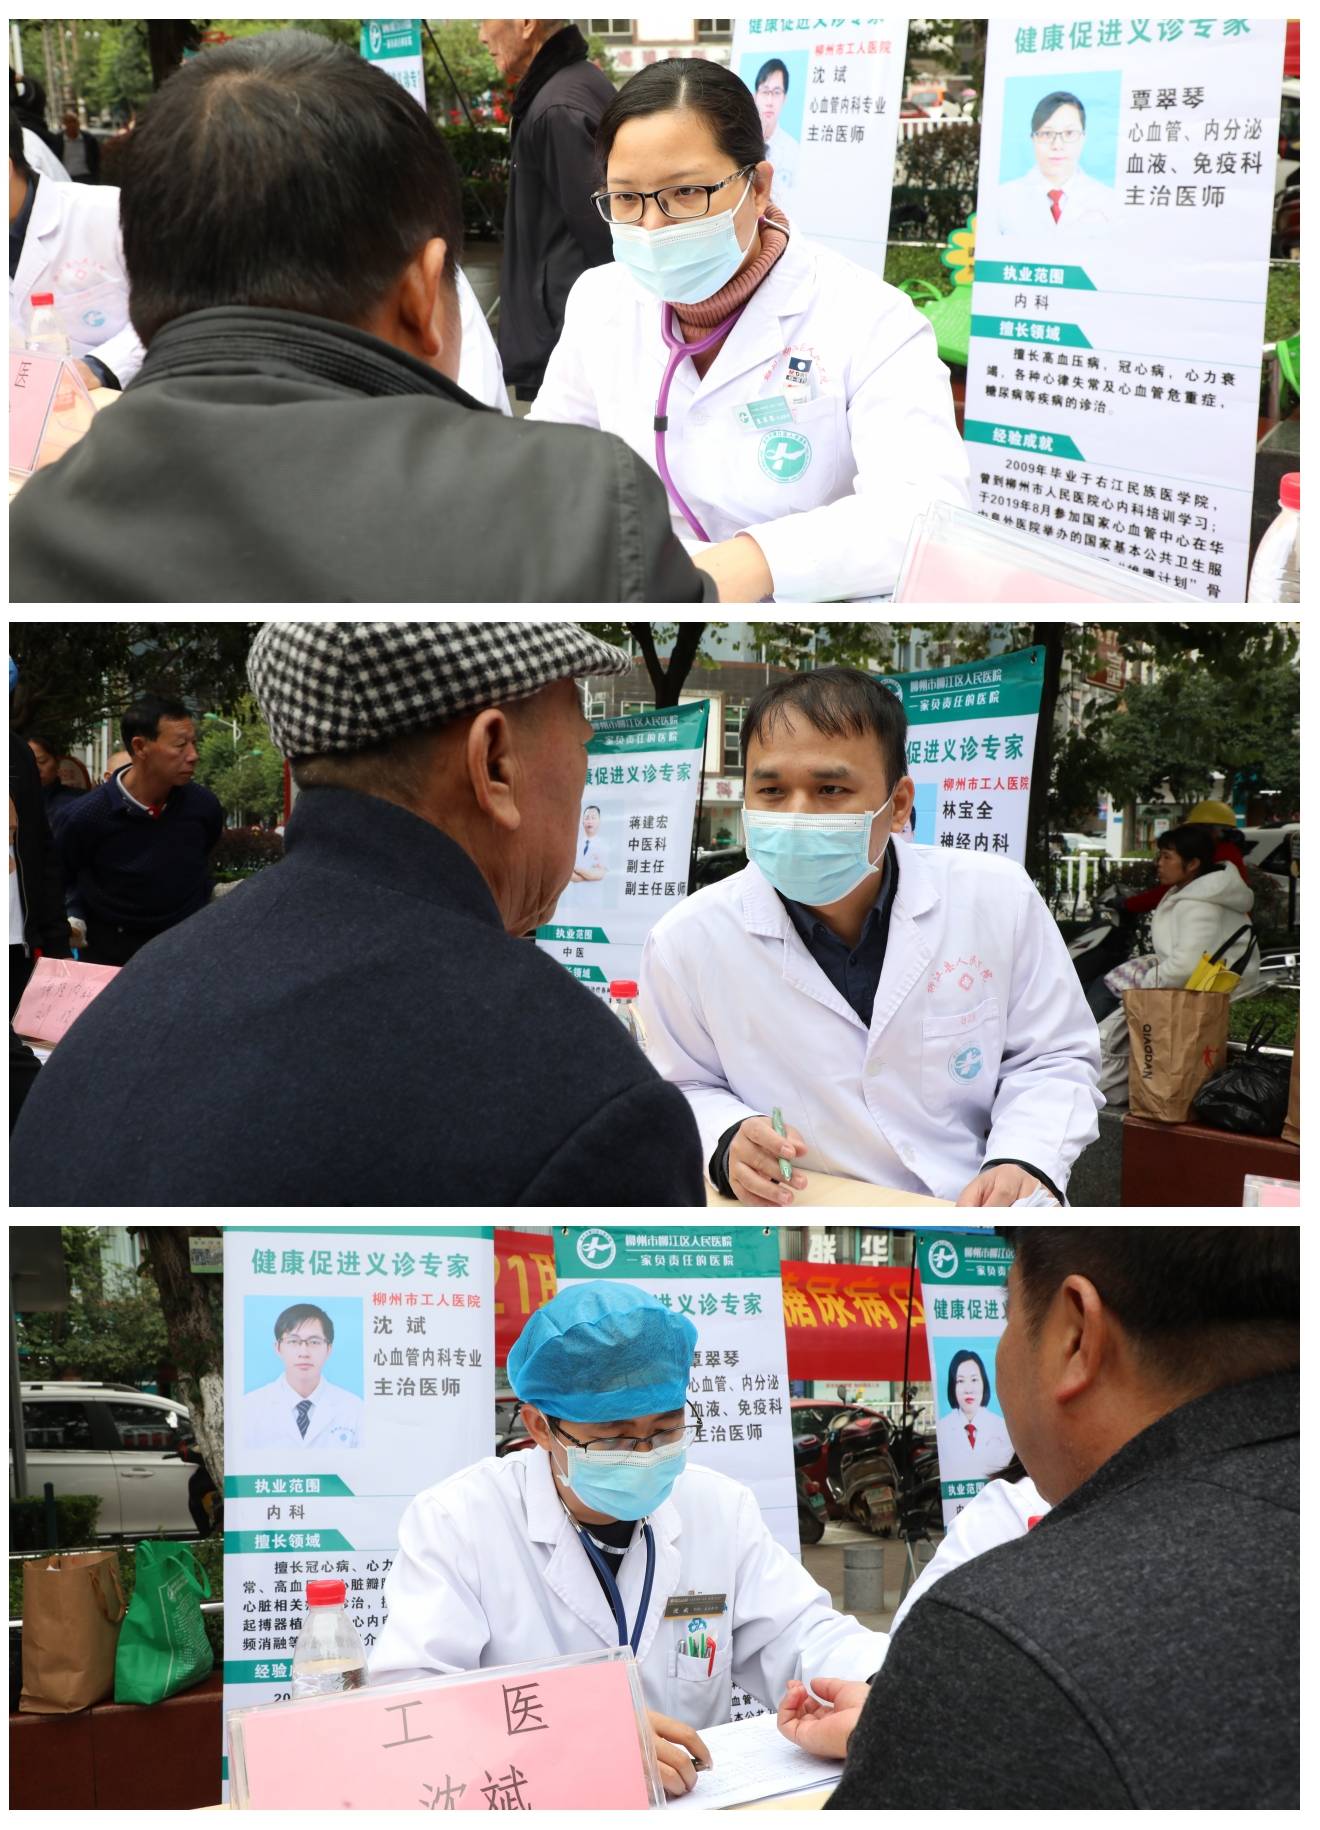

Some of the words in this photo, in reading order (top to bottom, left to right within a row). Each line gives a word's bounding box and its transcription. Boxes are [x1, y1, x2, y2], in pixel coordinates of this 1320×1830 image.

[810, 96, 887, 115] 心血管内科专业
[1130, 86, 1206, 111] 覃翠琴
[807, 125, 865, 143] 主治医师
[1128, 118, 1263, 143] 心血管、内分泌
[1126, 151, 1263, 176] 血液、免疫科
[1124, 185, 1226, 208] 主治医师
[1002, 265, 1064, 284] 执业范围
[1014, 292, 1049, 311] 内科
[999, 320, 1061, 341] 擅长领域
[992, 427, 1053, 452] 经验成就
[906, 733, 1024, 764] 促进义诊专家
[943, 776, 1030, 791] 柳州市工人医院
[942, 800, 993, 820] 林宝全
[629, 815, 668, 830] 蒋建宏
[628, 837, 667, 852] 中医科
[940, 831, 1009, 852] 神经内科
[626, 859, 665, 874] 副主任
[625, 881, 687, 897] 副主任医师
[555, 928, 593, 940] 执业范围
[1143, 1023, 1152, 1081] QIAODAN
[625, 1234, 732, 1248] 柳州市柳江区人民医院
[251, 1248, 470, 1278] 健康促进义诊专家
[626, 1254, 734, 1267] 一家负责任的医院
[372, 1292, 481, 1308] 柳州市工人医院
[373, 1315, 427, 1335] 沈斌
[373, 1347, 482, 1368] 心血管内科专业
[374, 1377, 461, 1397] 主治医师
[688, 1374, 779, 1392] 心血管、内分泌
[690, 1399, 782, 1418] 血液、免疫科
[254, 1478, 320, 1493] 执业范围
[267, 1505, 305, 1520] 内科
[254, 1533, 321, 1549] 擅长领域
[254, 1663, 293, 1679] 经验
